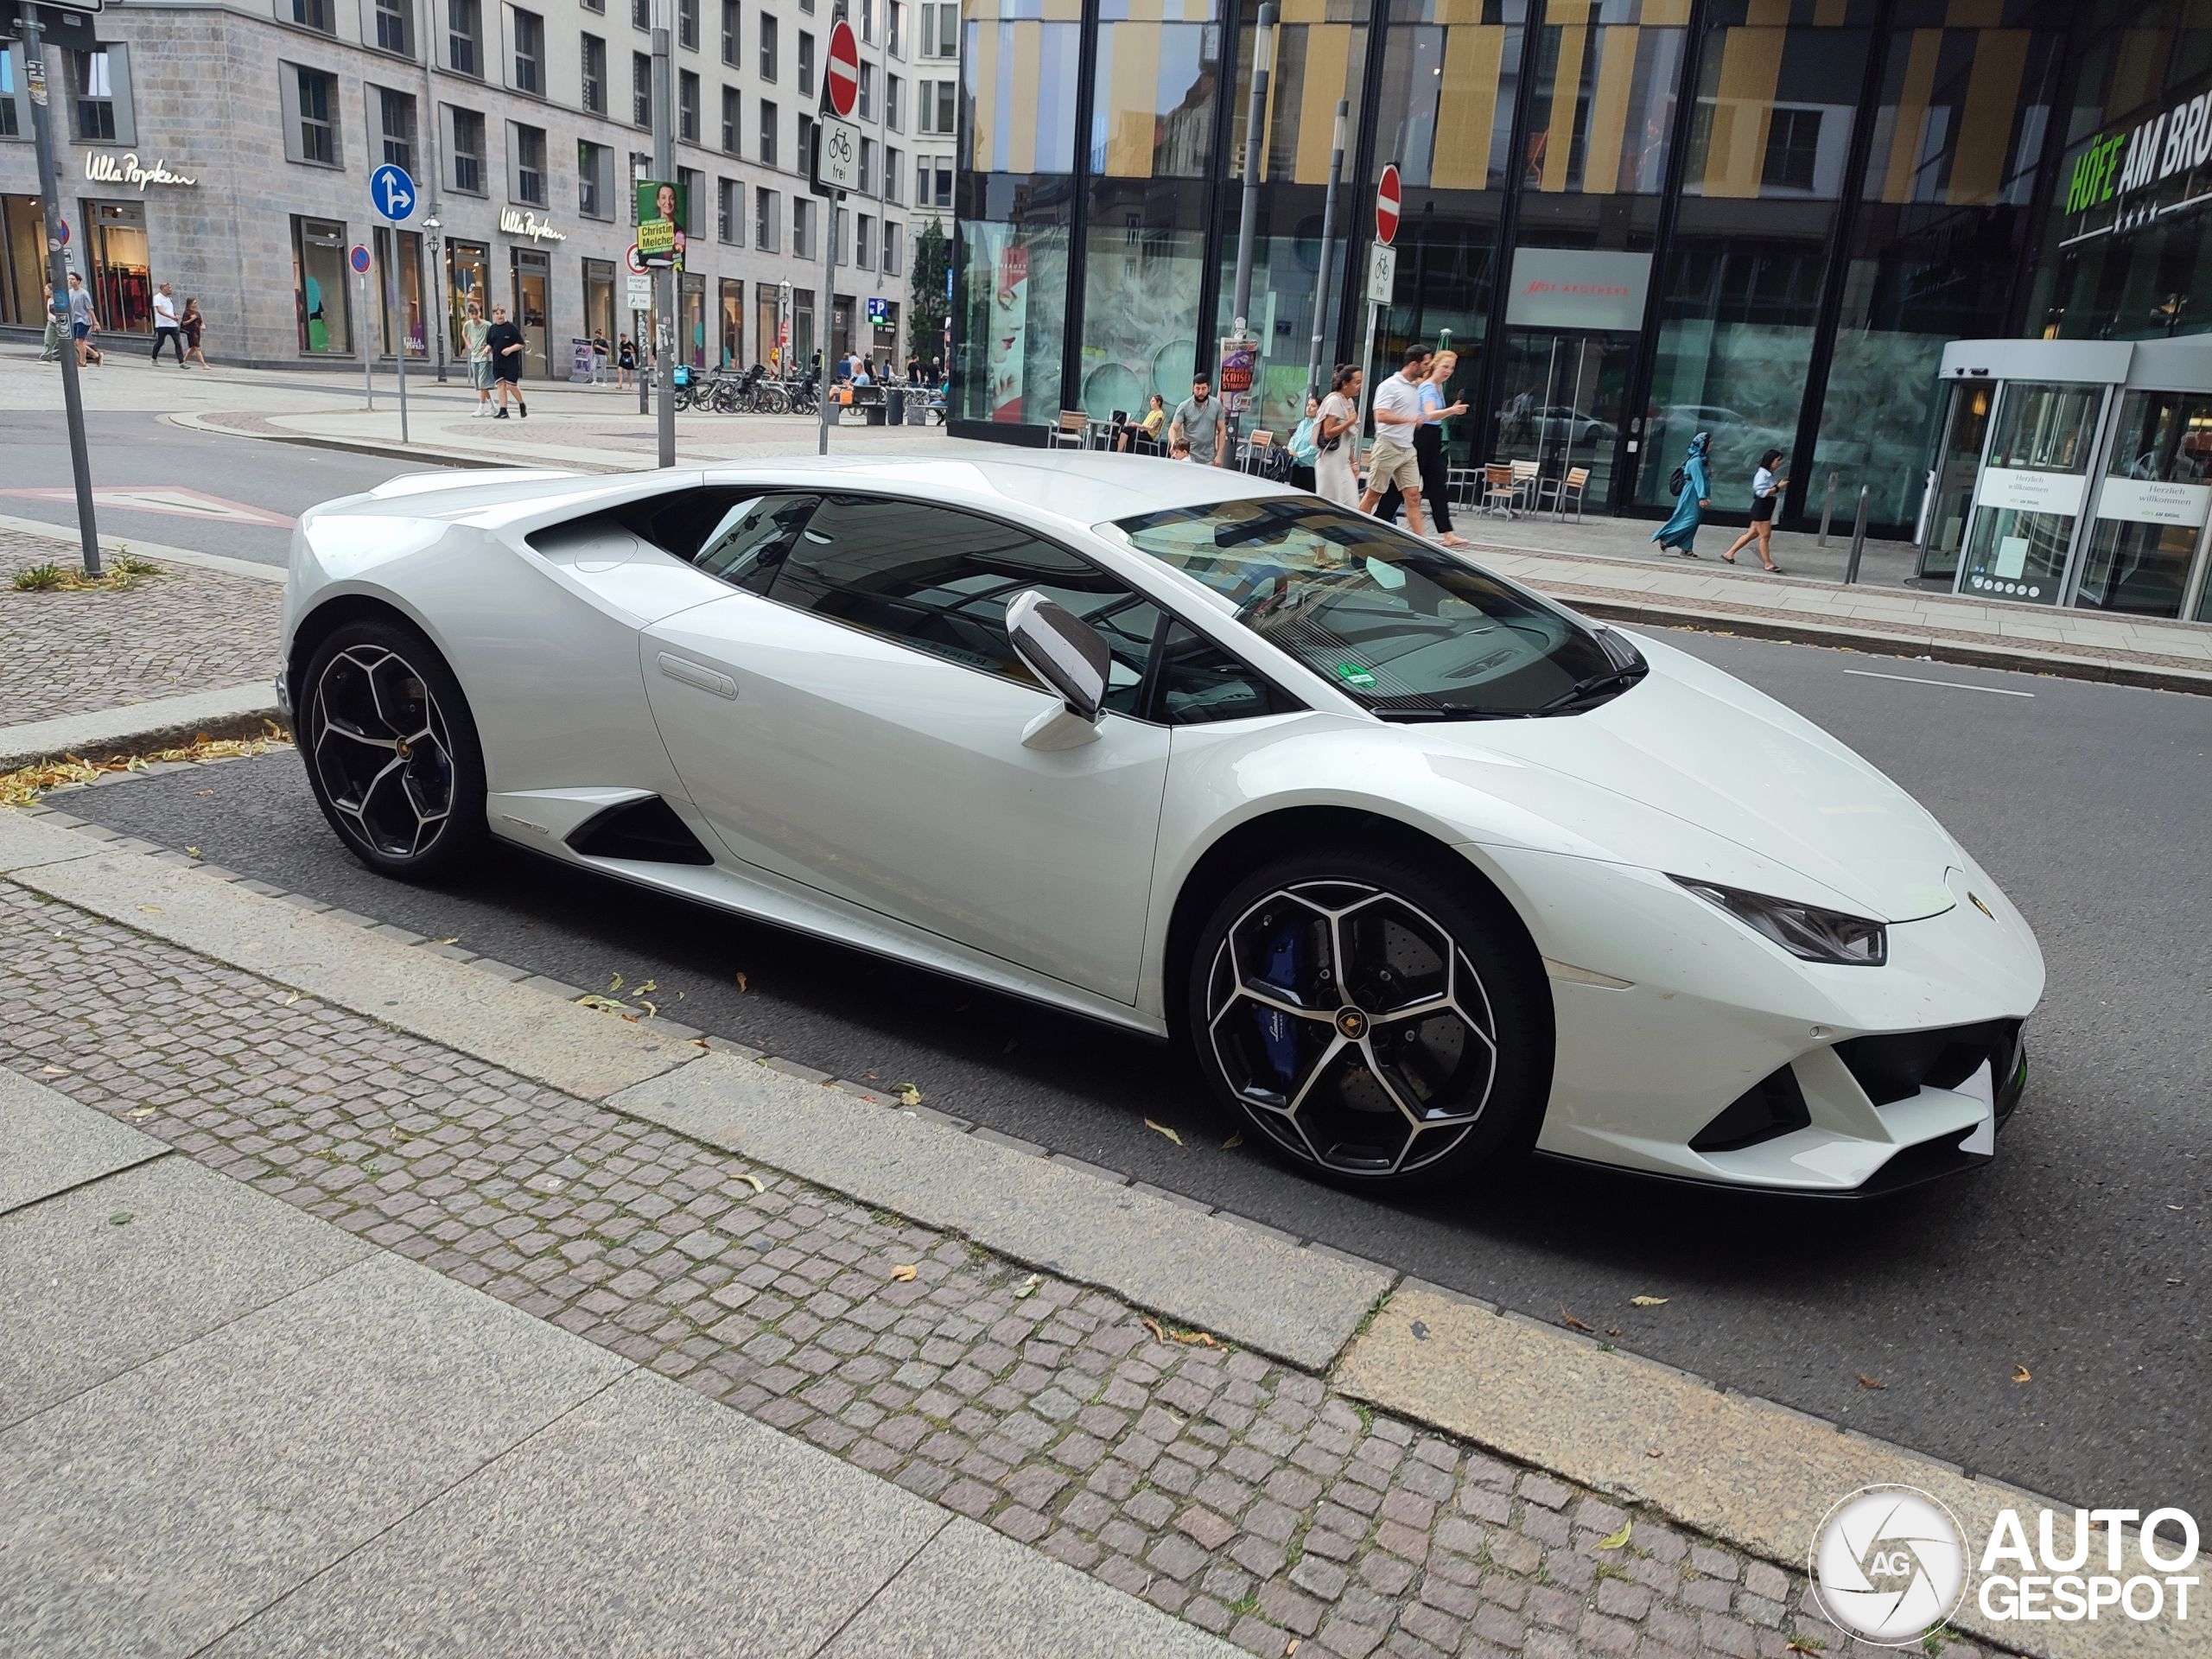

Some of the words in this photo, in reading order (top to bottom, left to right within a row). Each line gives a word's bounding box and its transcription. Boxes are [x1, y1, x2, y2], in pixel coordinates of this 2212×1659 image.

[2065, 132, 2126, 216] HÖFE
[2116, 112, 2167, 197] AM
[86, 150, 123, 181] Ulla
[123, 152, 197, 192] Popken
[833, 163, 846, 181] frei
[500, 207, 524, 234] Ulla
[524, 211, 567, 244] Popken
[641, 224, 672, 237] Christin
[642, 236, 673, 248] Melcher
[876, 302, 886, 315] P
[2016, 474, 2044, 484] Herzlich
[2008, 483, 2049, 493] willkommen
[2149, 485, 2185, 496] Herzlich
[2139, 494, 2191, 506] willkommen
